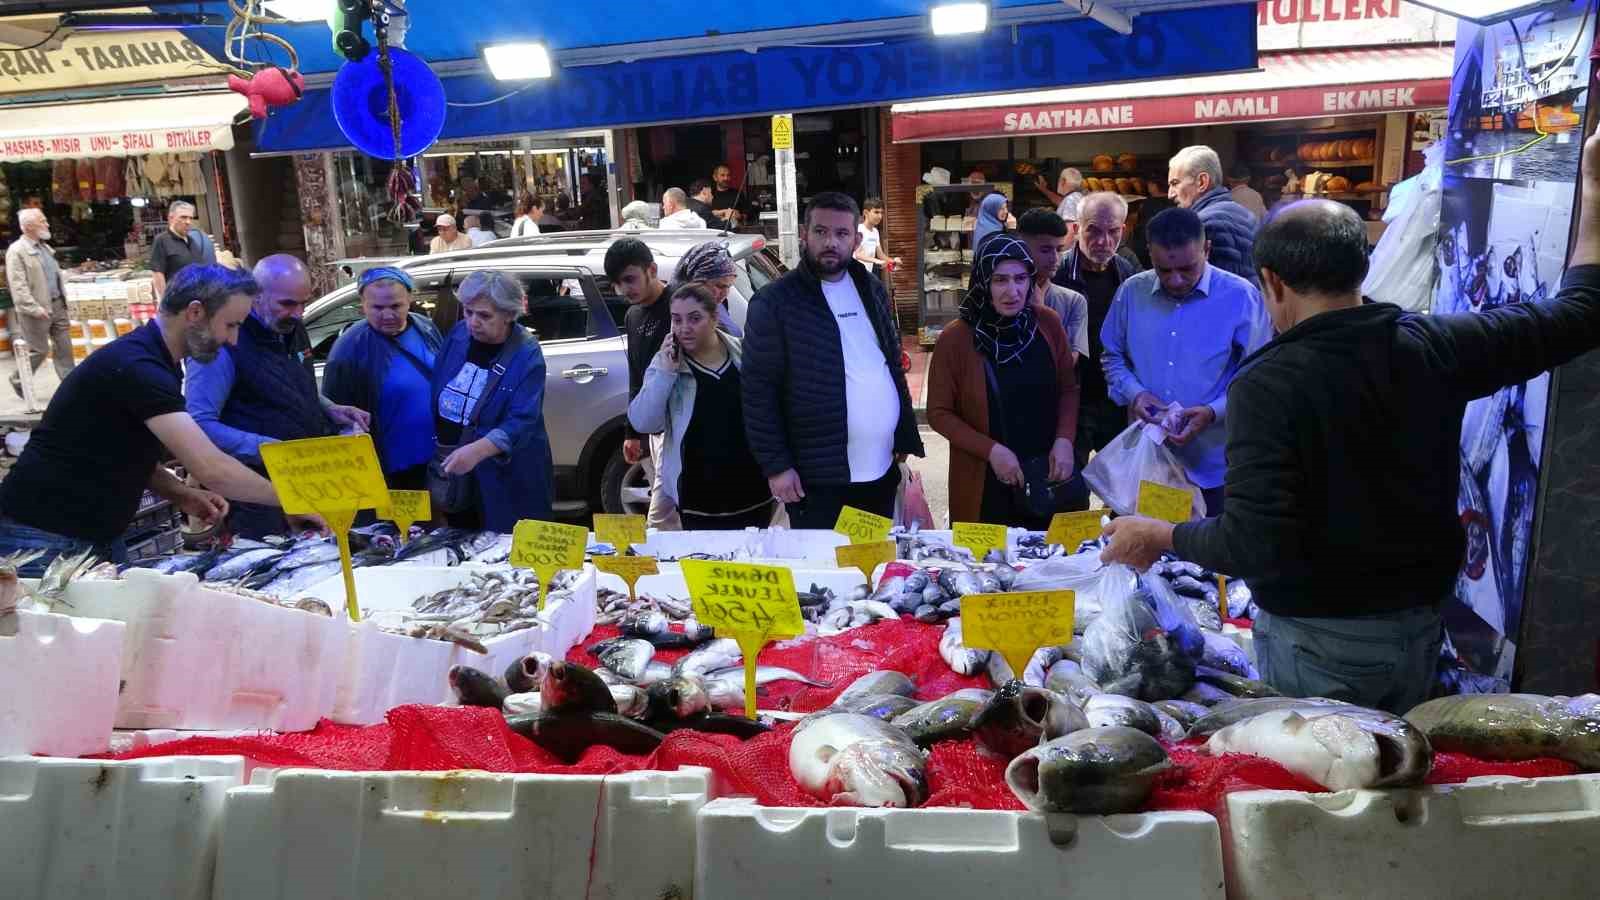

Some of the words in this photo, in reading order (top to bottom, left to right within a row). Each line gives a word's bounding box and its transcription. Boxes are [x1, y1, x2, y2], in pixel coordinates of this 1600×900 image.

[1003, 105, 1134, 132] SAATHANE
[1194, 95, 1278, 119] NAMLI
[1323, 87, 1417, 112] EKMEK
